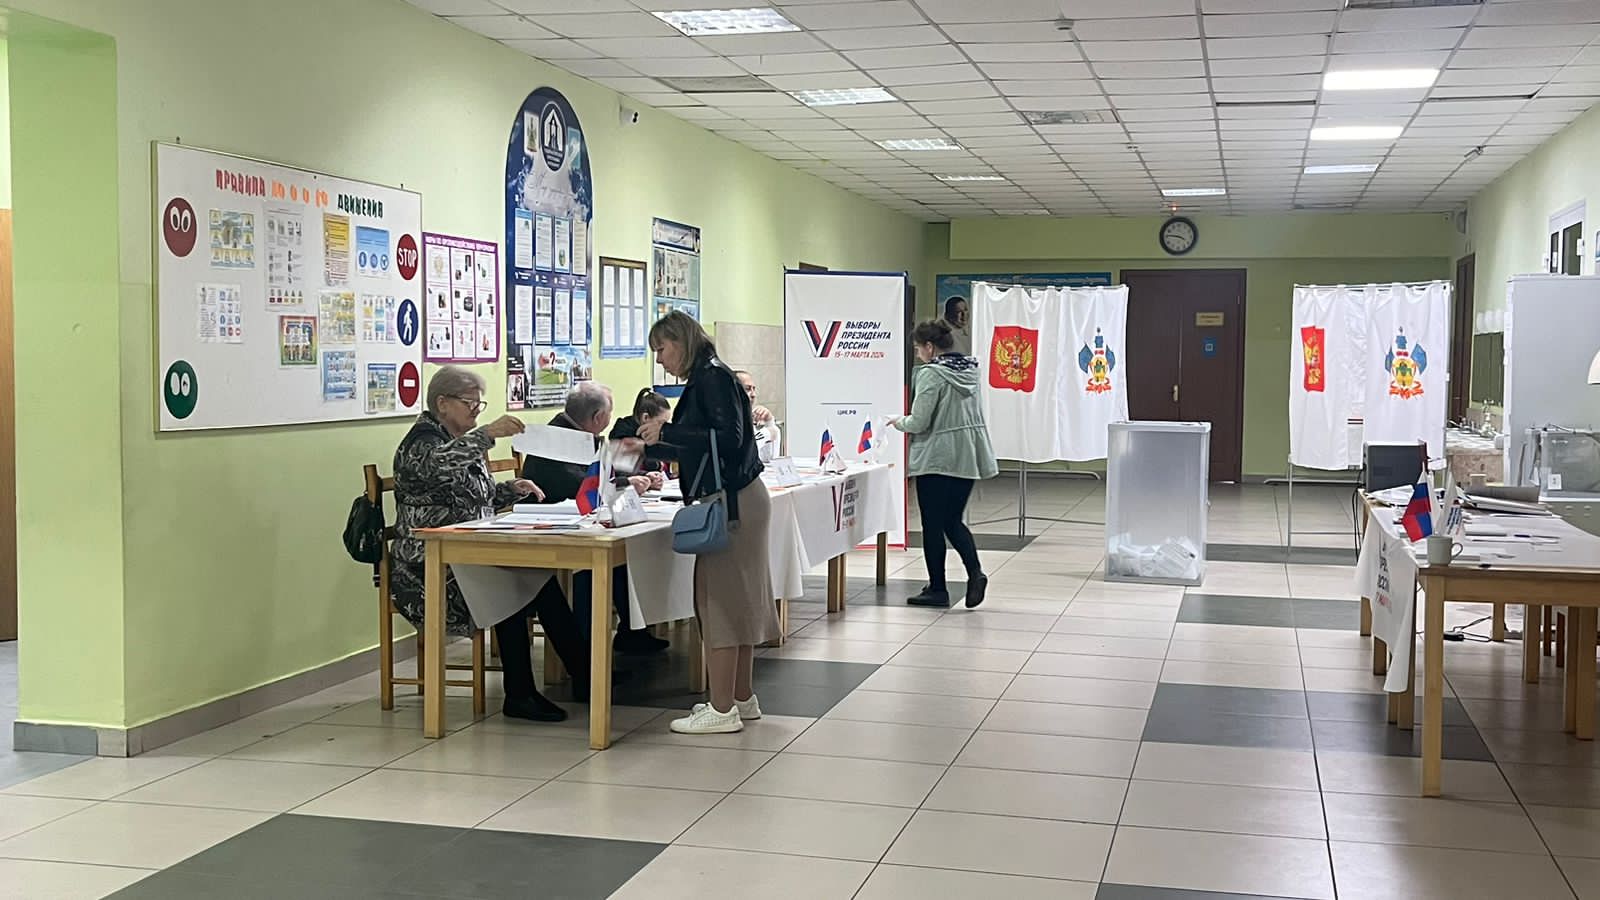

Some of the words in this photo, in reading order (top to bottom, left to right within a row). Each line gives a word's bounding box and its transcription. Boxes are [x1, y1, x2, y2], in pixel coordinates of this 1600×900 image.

[216, 169, 266, 197] ПРАВИЛА
[398, 248, 417, 267] STOP
[845, 321, 881, 329] ВЫБОРЫ
[841, 332, 891, 340] ПРЕЗИДЕНТА
